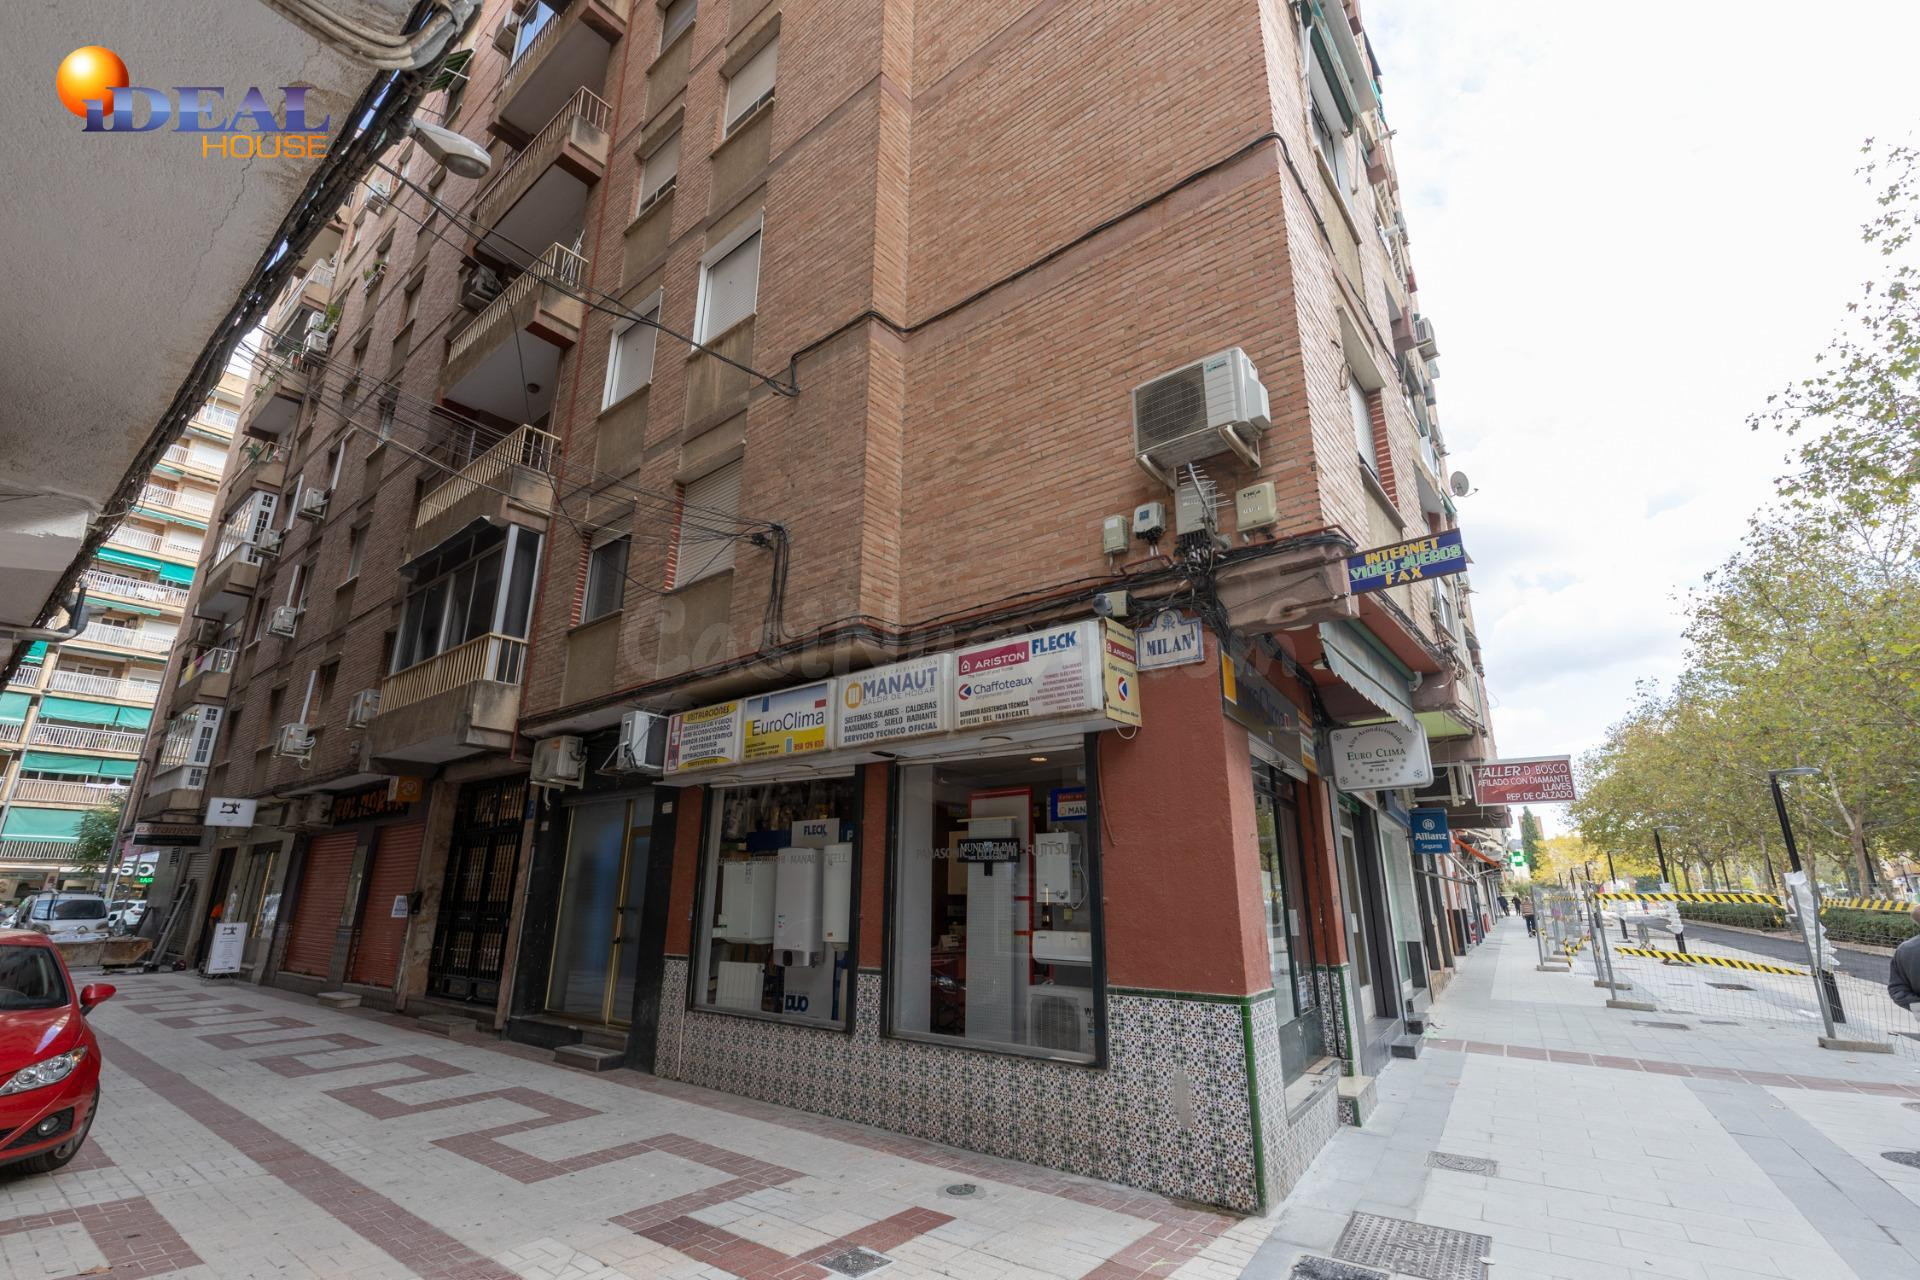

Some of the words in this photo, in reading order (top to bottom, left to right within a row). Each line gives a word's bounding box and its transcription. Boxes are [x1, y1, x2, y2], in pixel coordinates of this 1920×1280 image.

[1365, 537, 1439, 565] INTERNET
[1350, 560, 1395, 580] VIDEO
[1385, 566, 1423, 585] FAX
[1031, 630, 1077, 655] FLECK
[1147, 633, 1193, 656] MILAN
[975, 651, 1025, 669] ARISTON
[863, 666, 938, 699] MANAUT
[973, 677, 1032, 695] Chaffoteaux
[863, 695, 888, 706] CALOR
[891, 692, 902, 700] DE
[905, 687, 935, 698] HOGAR
[845, 713, 871, 724] SISTEMAS
[873, 707, 899, 719] SOLARES
[905, 701, 937, 713] CALDERAS
[884, 717, 903, 726] SUELO
[906, 711, 937, 723] RADIANTE
[960, 708, 980, 718] SERVICIO
[980, 703, 1007, 714] ASISTENCIA
[960, 716, 980, 726] OFICIAL
[995, 709, 1029, 720] FABRICANTE
[752, 711, 824, 737] EuroClima
[844, 731, 874, 743] SERVICIO
[876, 727, 906, 737] TECNICO
[908, 721, 938, 732] OFICIAL
[1477, 766, 1520, 778] TALLER
[1535, 763, 1568, 775] BOSCO
[1478, 778, 1509, 787] AFILADO
[1511, 777, 1528, 785] CON
[1529, 775, 1570, 785] DIAMANTE
[1542, 783, 1572, 791] LLAVES
[1506, 793, 1522, 801] REP.
[1523, 792, 1534, 800] DE
[1535, 790, 1573, 799] CALZADO
[1415, 832, 1447, 841] Allianz
[1421, 843, 1443, 851] Seguros
[785, 995, 808, 1012] DUO
